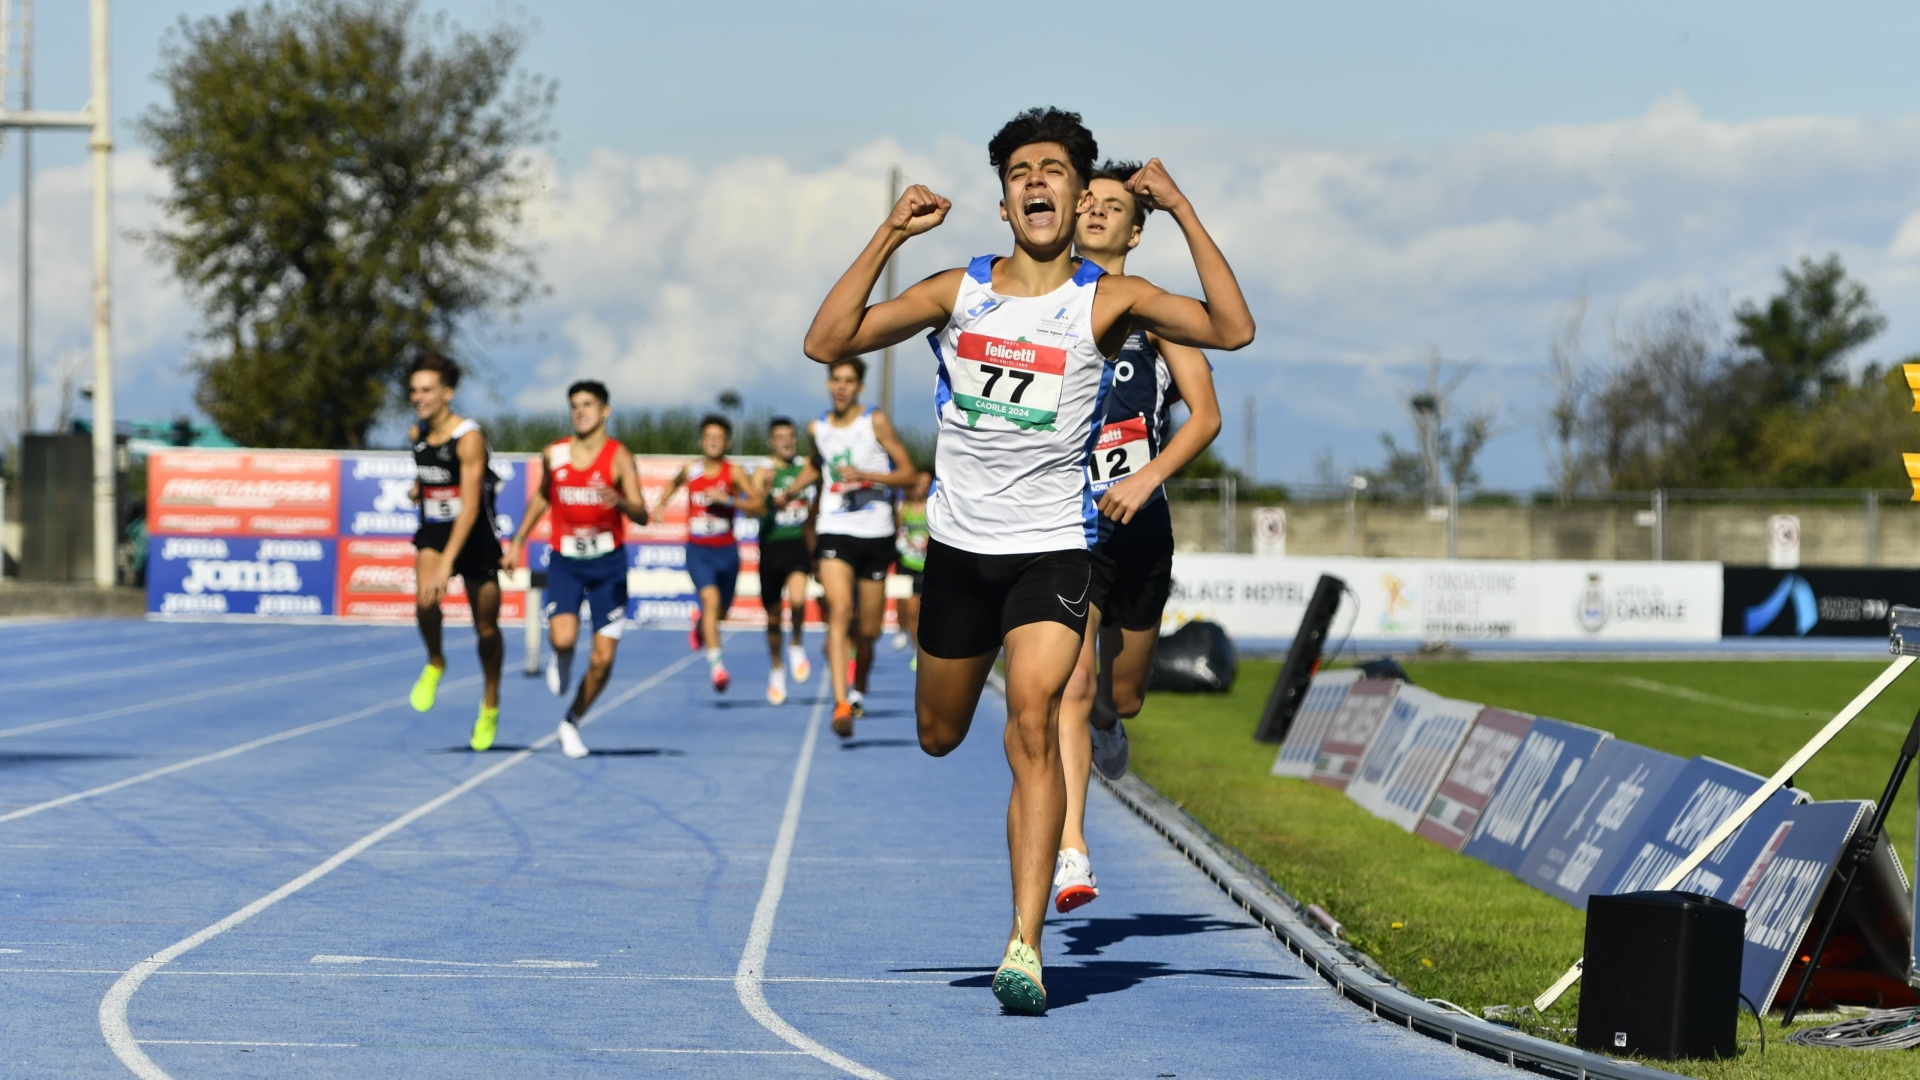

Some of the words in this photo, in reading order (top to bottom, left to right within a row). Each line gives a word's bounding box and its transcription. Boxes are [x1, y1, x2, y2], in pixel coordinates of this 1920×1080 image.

[985, 341, 1036, 363] felicetti
[980, 364, 1035, 404] 77
[975, 400, 1007, 413] CAORLE
[1008, 406, 1029, 417] 2024
[1090, 447, 1131, 481] 12
[1244, 580, 1304, 603] HOTEL
[1615, 601, 1686, 622] CAORLE
[1744, 856, 1805, 945] CAORLE
[1762, 860, 1828, 952] 2024
